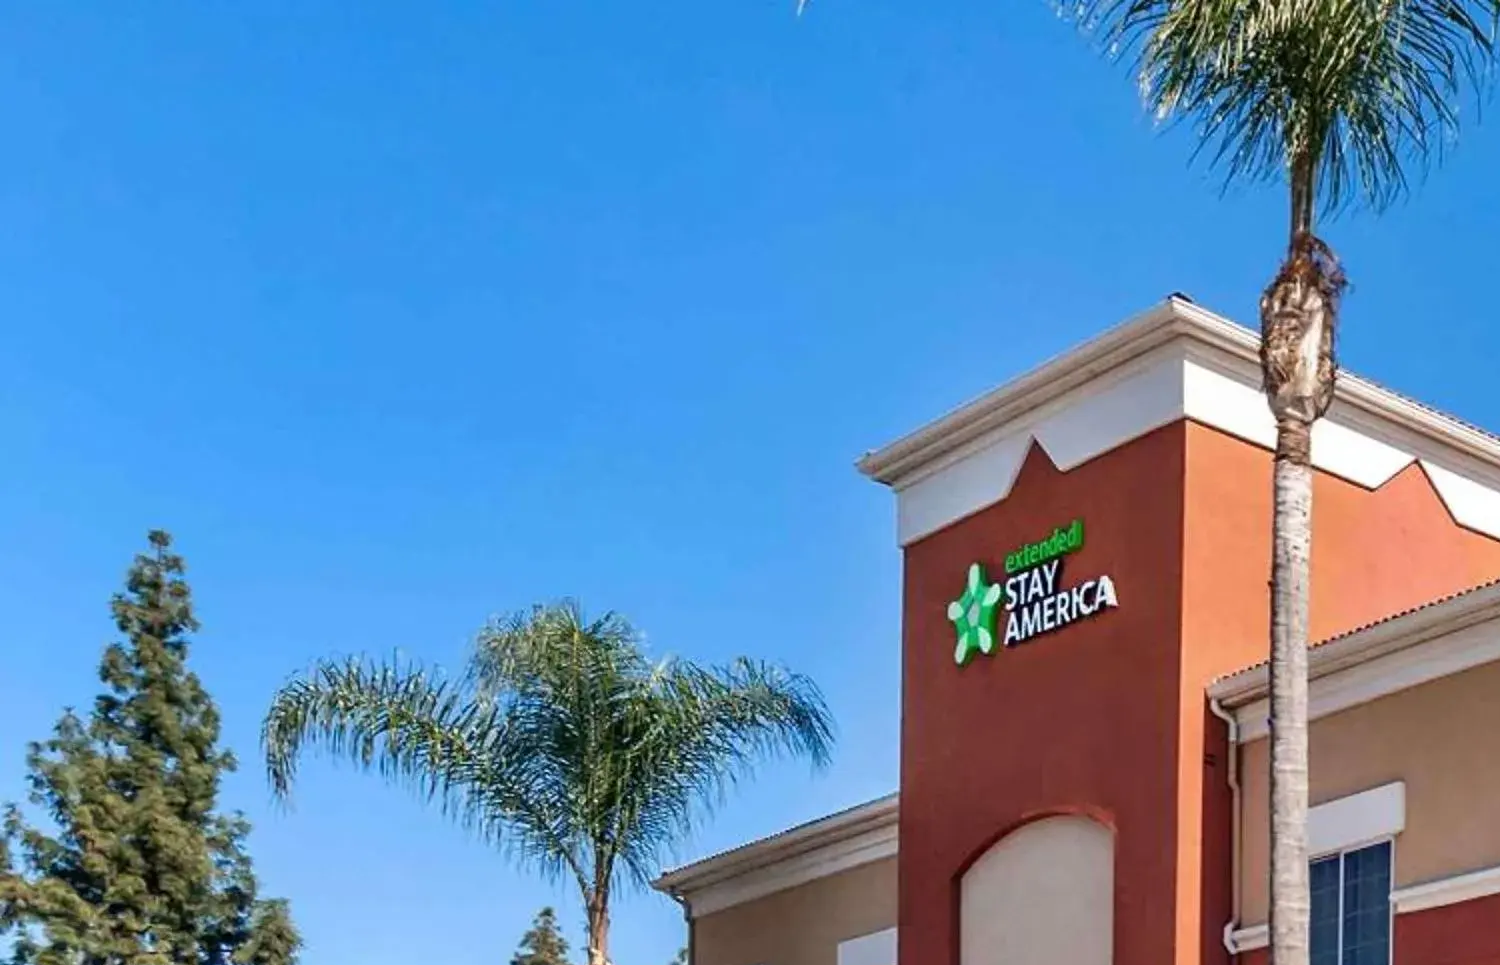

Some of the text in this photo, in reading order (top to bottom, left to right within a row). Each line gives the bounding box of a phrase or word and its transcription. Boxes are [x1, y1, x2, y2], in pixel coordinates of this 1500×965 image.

[1005, 519, 1082, 573] extended
[1004, 575, 1118, 645] AMERICA
[1005, 559, 1059, 610] STAY
